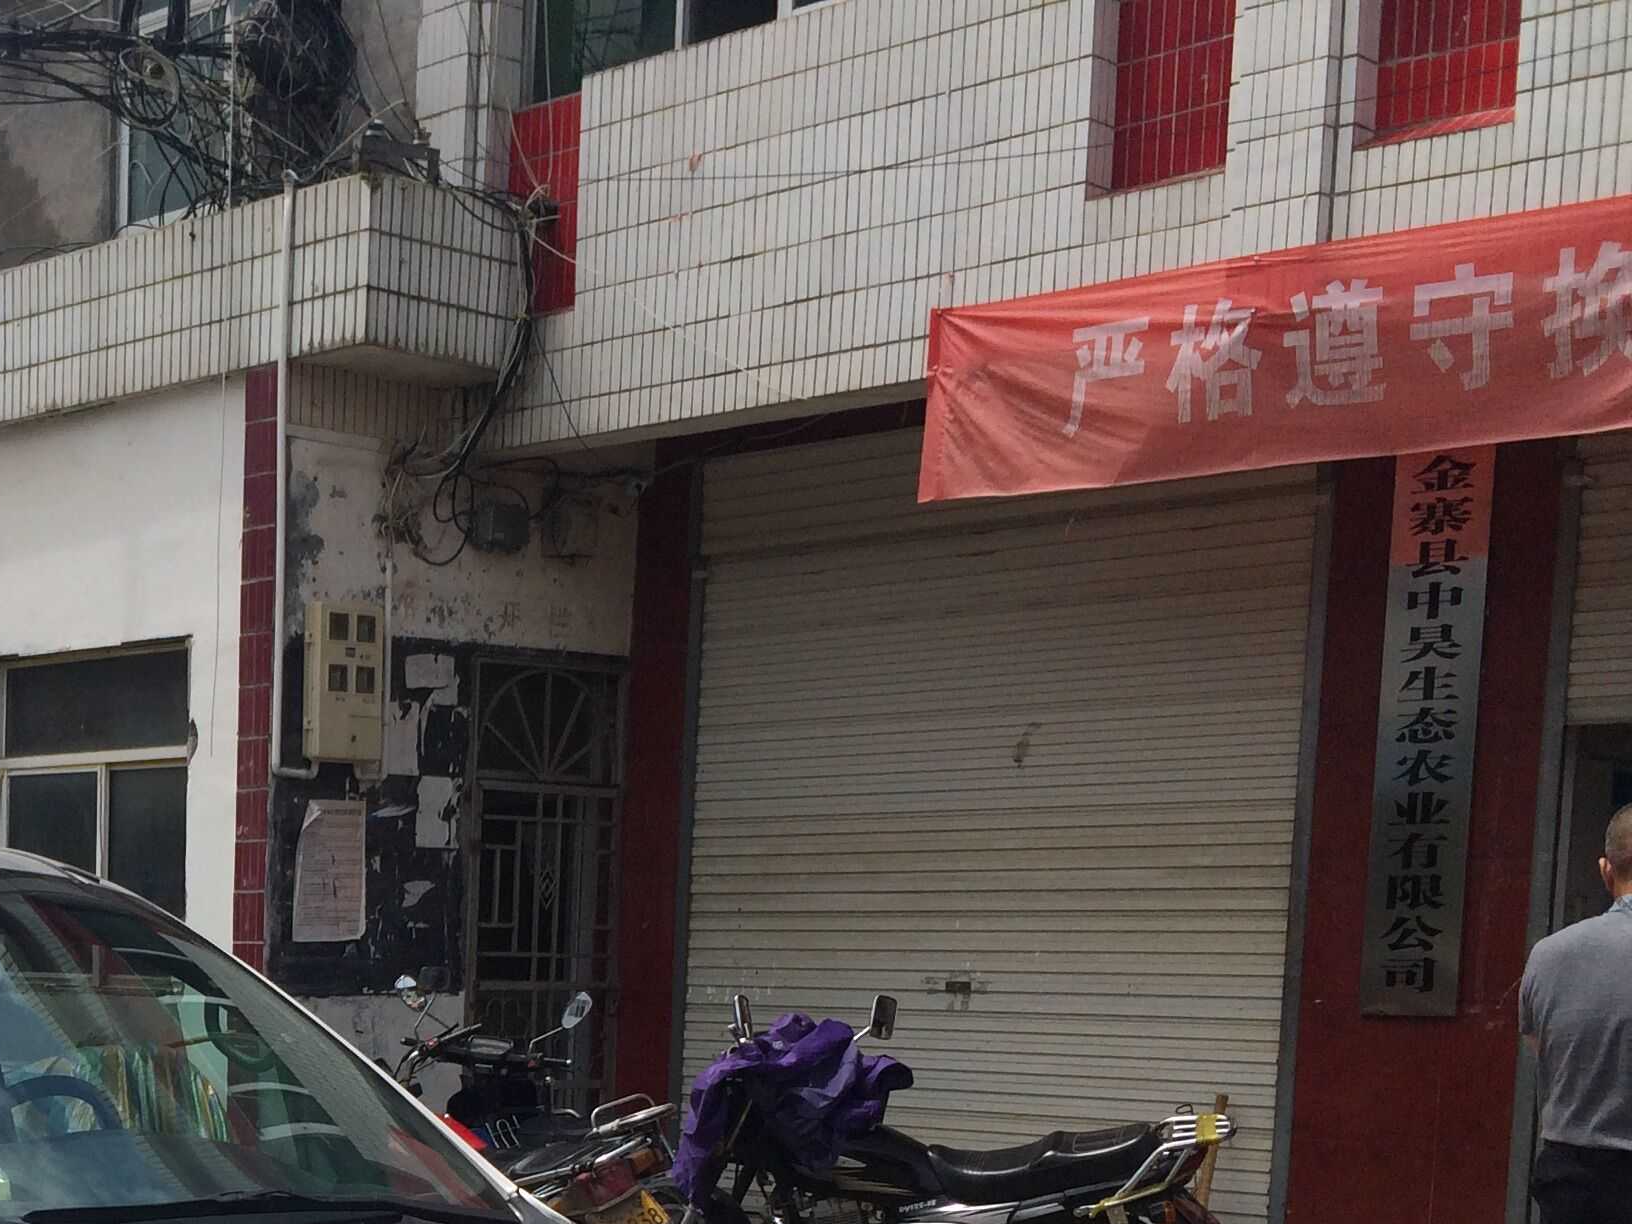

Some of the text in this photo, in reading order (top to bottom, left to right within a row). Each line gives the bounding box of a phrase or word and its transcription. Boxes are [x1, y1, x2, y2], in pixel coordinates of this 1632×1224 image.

[1380, 453, 1475, 993] 金寨县中昊生态农业有限公司
